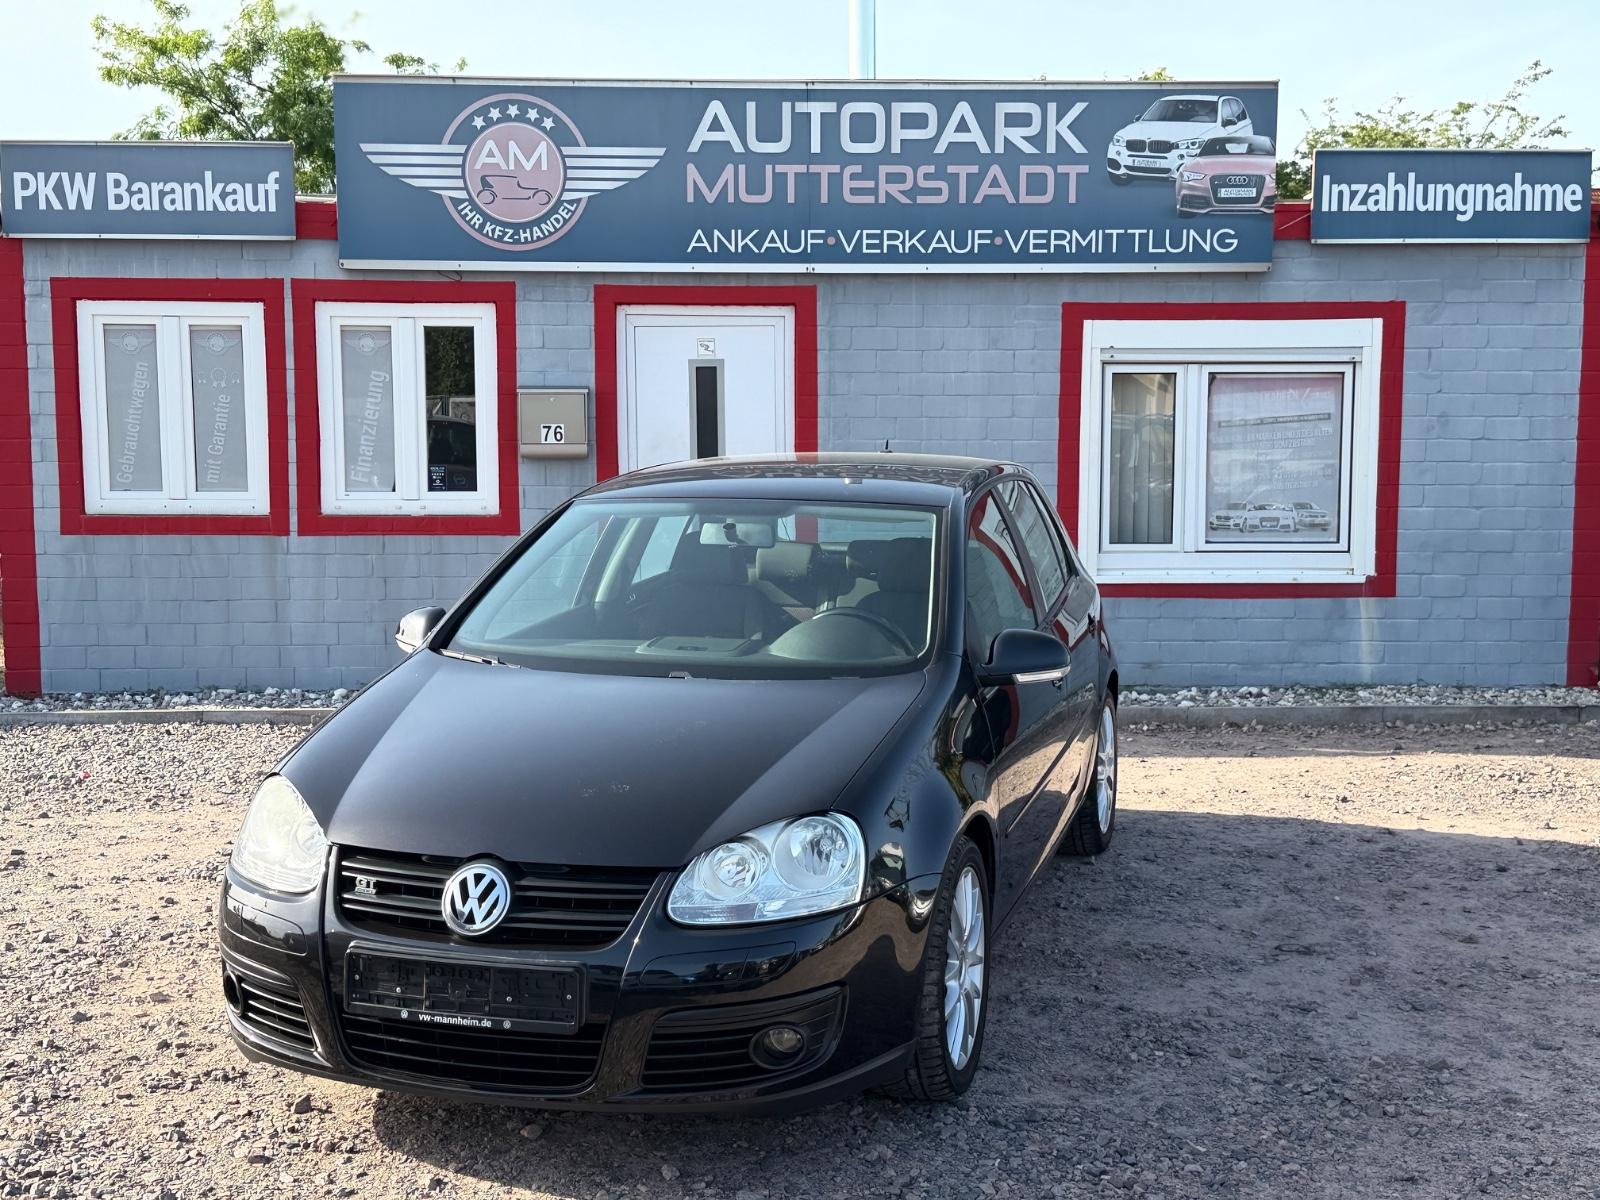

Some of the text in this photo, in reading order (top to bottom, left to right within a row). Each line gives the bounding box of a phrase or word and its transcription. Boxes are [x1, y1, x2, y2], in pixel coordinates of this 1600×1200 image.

[687, 99, 1089, 156] AUTOPARK
[474, 139, 548, 172] AM
[13, 171, 280, 213] PKW Barankauf
[686, 163, 1090, 205] MUTTERSTADT
[1321, 172, 1583, 222] Inzahlungnahme
[457, 201, 577, 243] IHR KFZ-HANDEL
[686, 228, 1239, 255] ANKAUF VERKAUF VERMITTLUNG
[117, 360, 151, 484] Gebrauchtwagen
[205, 393, 231, 484] mit Garantie
[350, 370, 390, 484] Finanzierung
[542, 425, 563, 442] 76
[355, 876, 377, 889] GT
[448, 869, 504, 931] VW
[418, 1012, 492, 1027] vw-mannheim.de
